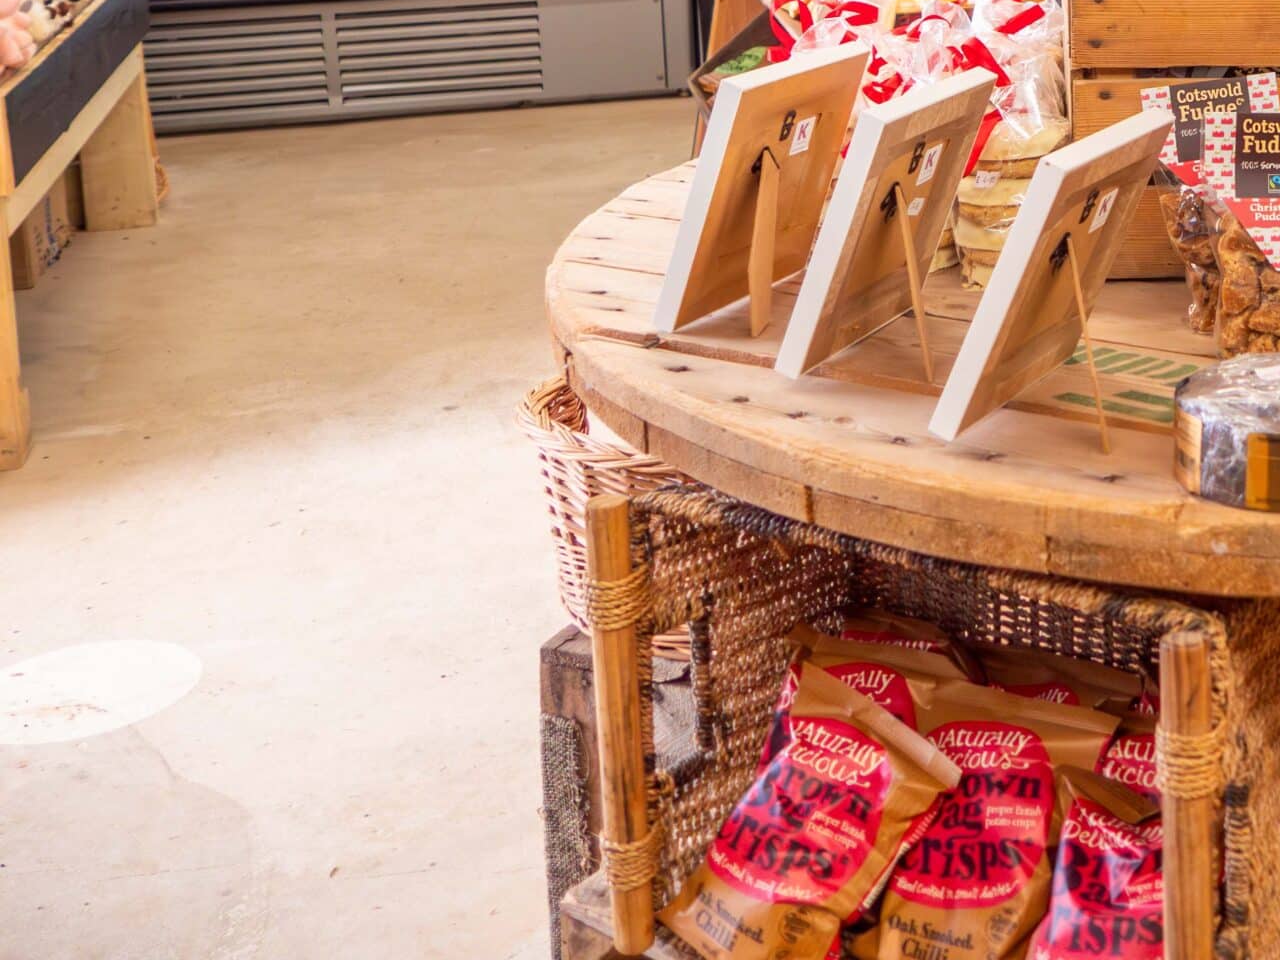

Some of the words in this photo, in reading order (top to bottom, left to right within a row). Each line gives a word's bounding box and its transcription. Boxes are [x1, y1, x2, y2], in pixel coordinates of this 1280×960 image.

[1177, 82, 1243, 104] Cotswold
[798, 122, 809, 140] K
[925, 150, 937, 170] K
[961, 774, 1041, 799] own
